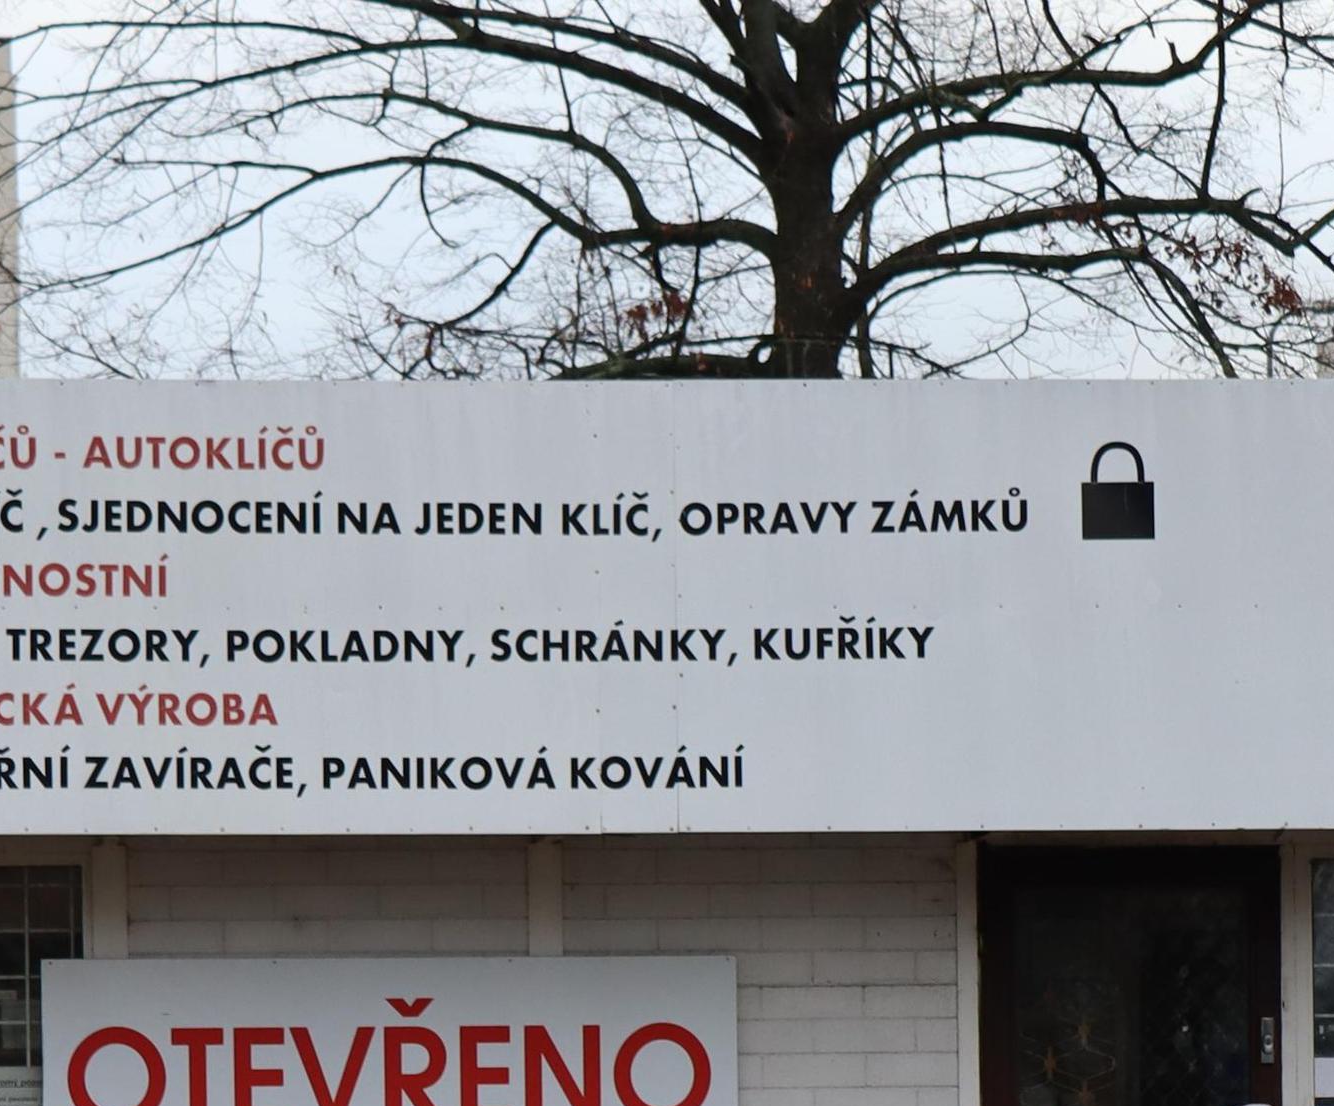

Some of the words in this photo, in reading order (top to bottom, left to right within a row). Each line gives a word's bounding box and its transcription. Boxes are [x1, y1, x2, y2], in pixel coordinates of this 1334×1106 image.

[84, 426, 324, 470] AUTOKLÍČŮ
[338, 502, 401, 534] NA
[415, 503, 541, 535] JEDEN
[562, 492, 662, 542] KLÍČ,
[679, 502, 857, 536] OPRAVY
[871, 488, 1028, 533] ZÁMKŮ
[6, 629, 210, 668] TREZORY,
[227, 629, 476, 667] POKLADNY,
[491, 620, 738, 666] SCHRÁNKY,
[754, 616, 934, 660] KUFŘÍKY
[96, 692, 278, 727] VÝROBA
[84, 744, 307, 797] ZAVÍRAČE,
[323, 746, 556, 790] PANIKOVÁ
[571, 745, 744, 789] KOVÁNÍ
